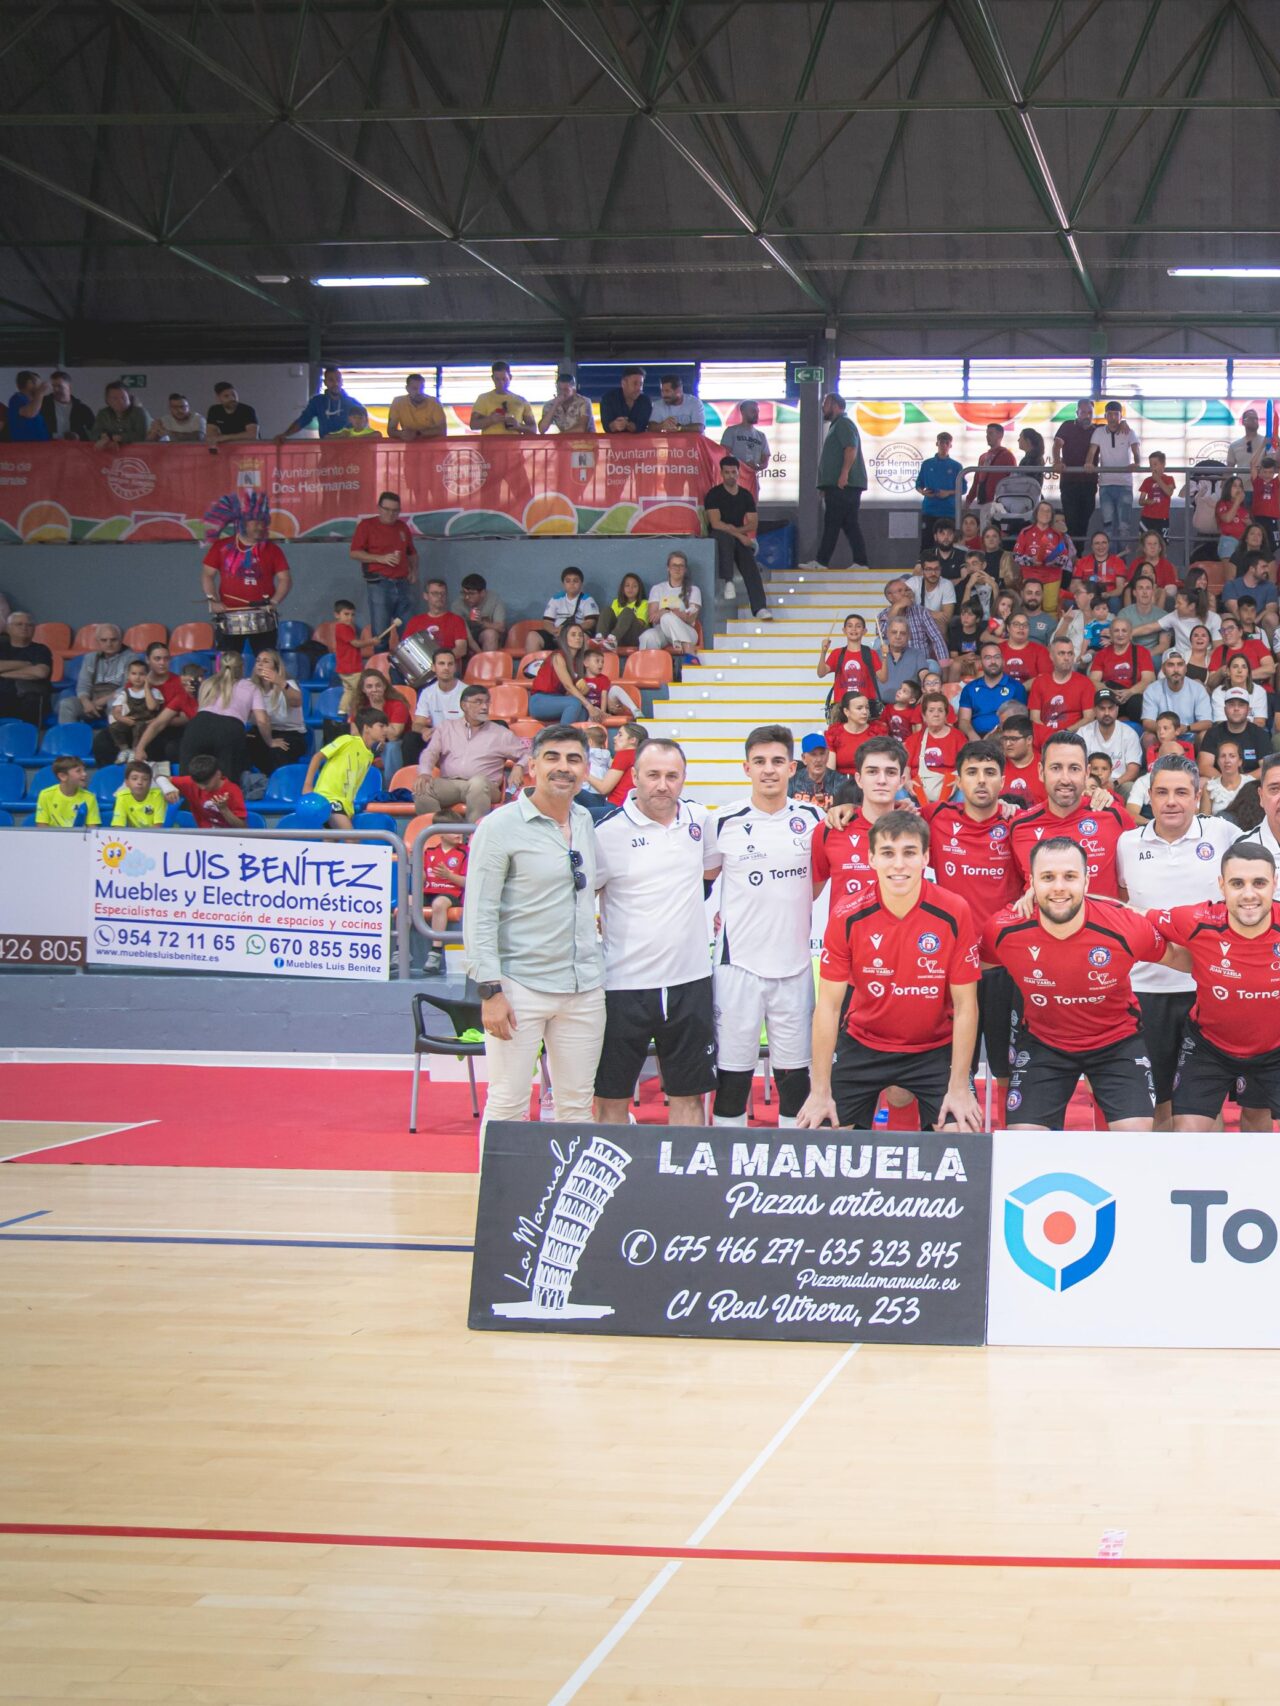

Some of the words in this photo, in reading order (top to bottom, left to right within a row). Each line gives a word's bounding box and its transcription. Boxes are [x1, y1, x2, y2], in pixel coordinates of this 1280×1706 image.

[773, 452, 787, 463] de
[887, 459, 923, 467] Herman
[272, 464, 343, 479] Ayuntamiento
[346, 463, 360, 474] de
[607, 463, 631, 475] Dos
[634, 463, 699, 476] Hermanas
[758, 469, 787, 478] anas
[900, 467, 920, 477] limpi
[272, 481, 296, 494] Dos
[298, 480, 360, 493] Hermanas
[631, 837, 649, 848] J.V.
[163, 850, 230, 880] LUIS
[239, 848, 384, 891] BENÍTEZ
[769, 866, 808, 880] Torneo
[961, 864, 1005, 876] Torneo
[95, 879, 178, 904] Muebles
[184, 890, 197, 907] y
[203, 885, 384, 915] Electrodomésticos
[95, 903, 169, 920] Especialistas
[174, 910, 188, 919] en
[191, 909, 254, 924] decoración
[258, 914, 272, 925] de
[277, 916, 325, 931] espacios
[329, 919, 337, 931] y
[342, 918, 384, 931] cocinas
[117, 929, 152, 947] 954
[158, 931, 180, 948] 72
[187, 932, 206, 950] 11
[213, 934, 236, 952] 65
[40, 938, 82, 962] 805
[96, 947, 220, 963] www.mueblesluisbenitez.es
[270, 937, 303, 956] 670
[309, 940, 343, 958] 855
[349, 942, 383, 961] 596
[286, 958, 323, 969] Muebles
[326, 961, 345, 971] Luis
[890, 982, 939, 996] Torneo
[1053, 994, 1107, 1005] Torneo
[657, 1141, 718, 1176] LA
[731, 1143, 968, 1182] MANUELA
[725, 1182, 823, 1219] Pizzas
[828, 1190, 965, 1219] artesanas
[664, 1235, 711, 1264] 675
[715, 1236, 757, 1264] 466
[869, 1239, 911, 1268] 323
[916, 1240, 962, 1270] 845
[796, 1269, 962, 1291] Pizzerialamanuela.es
[708, 1291, 770, 1322] Real
[771, 1293, 864, 1327] Utrera,
[868, 1296, 921, 1325] 253
